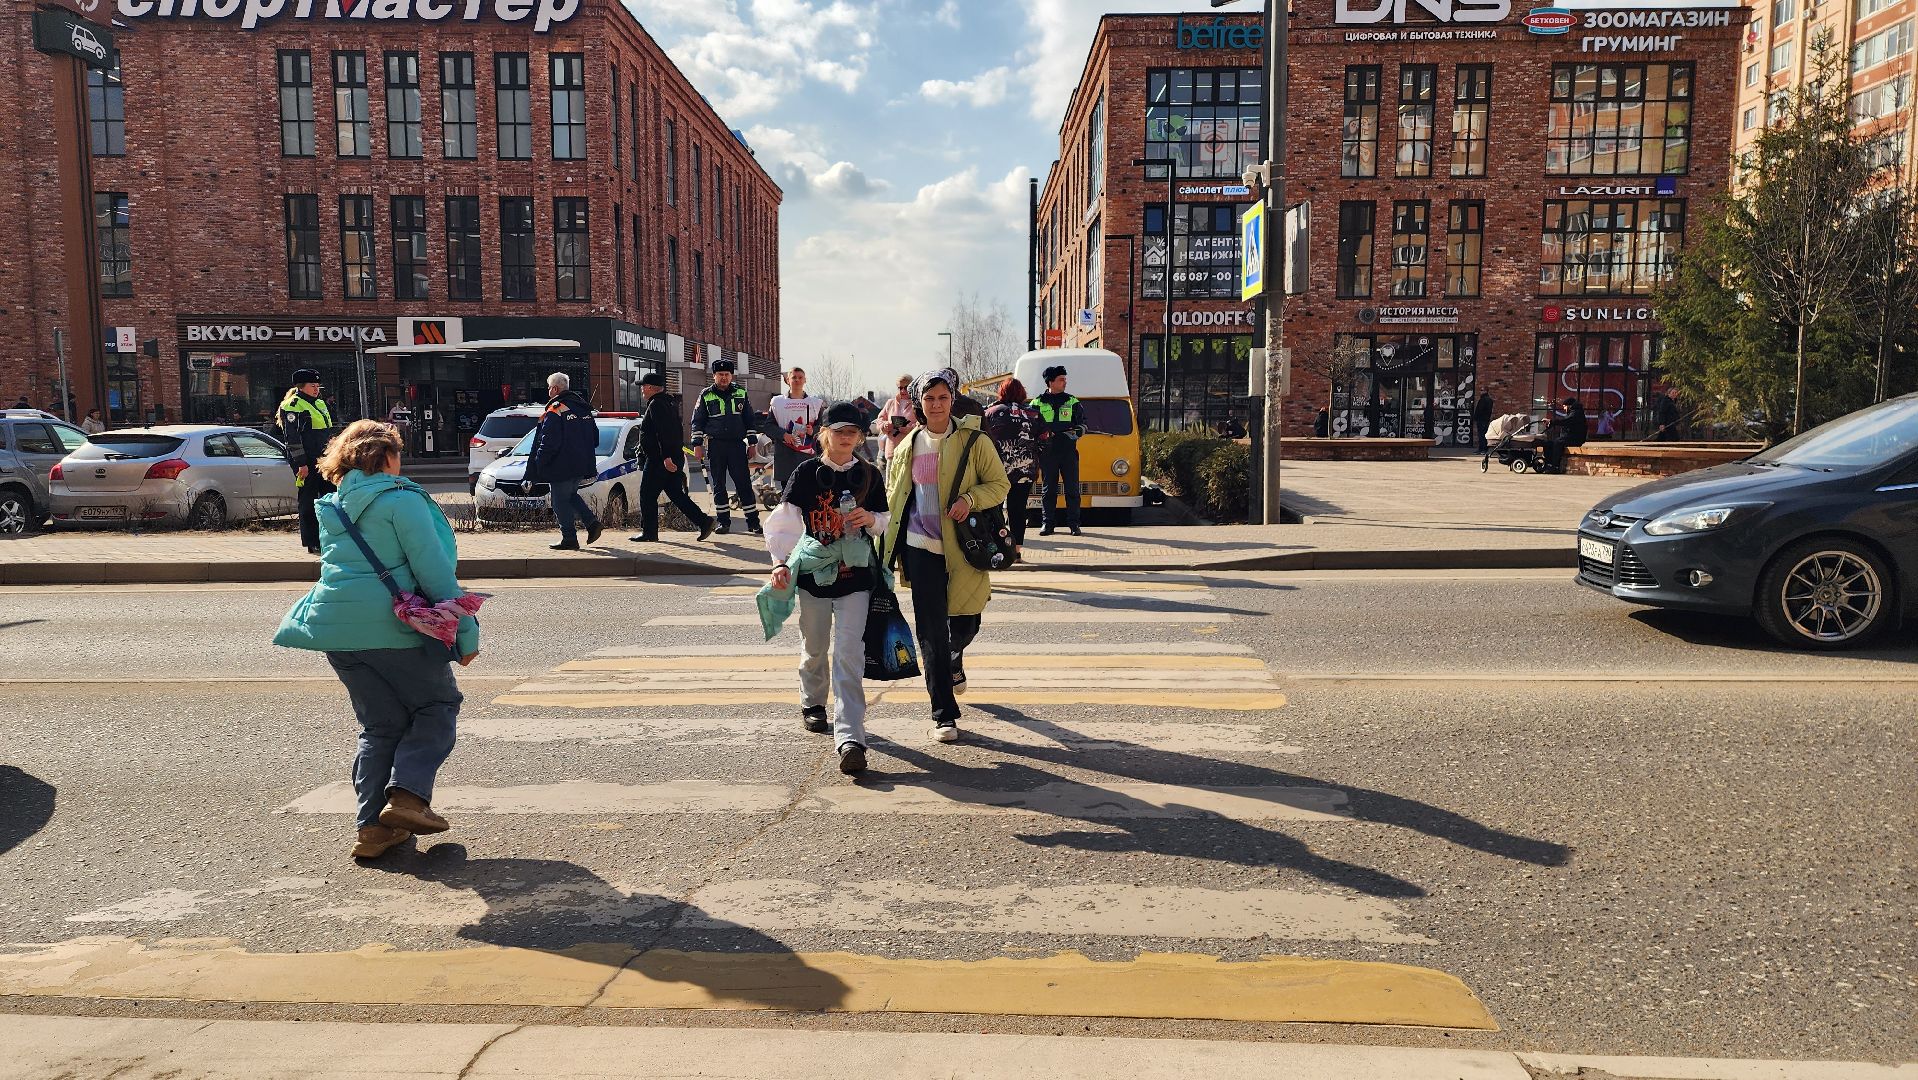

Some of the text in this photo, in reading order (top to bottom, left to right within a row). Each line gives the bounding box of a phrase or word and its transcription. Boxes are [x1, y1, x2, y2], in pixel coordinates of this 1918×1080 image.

[1583, 10, 1730, 28] ЗООМАГАЗИН
[1177, 15, 1264, 49] befree
[1345, 30, 1497, 41] ЦИФРОВАЯ И БЫТОВАЯ ТЕХНИКА
[1582, 35, 1683, 52] ГРУМИНГ
[1560, 186, 1655, 195] LAZURIT
[1150, 272, 1164, 282] +7
[1172, 272, 1187, 282] 66
[1188, 271, 1209, 281] 087
[1380, 307, 1459, 316] ИСТОРИЯ МЕСТА
[1566, 308, 1658, 320] SUNLIG
[123, 333, 130, 342] 3
[187, 325, 274, 341] ВКУСНО
[315, 326, 387, 342] ТОЧКА
[615, 329, 641, 349] ВКУСНО
[1457, 413, 1471, 444] 1589
